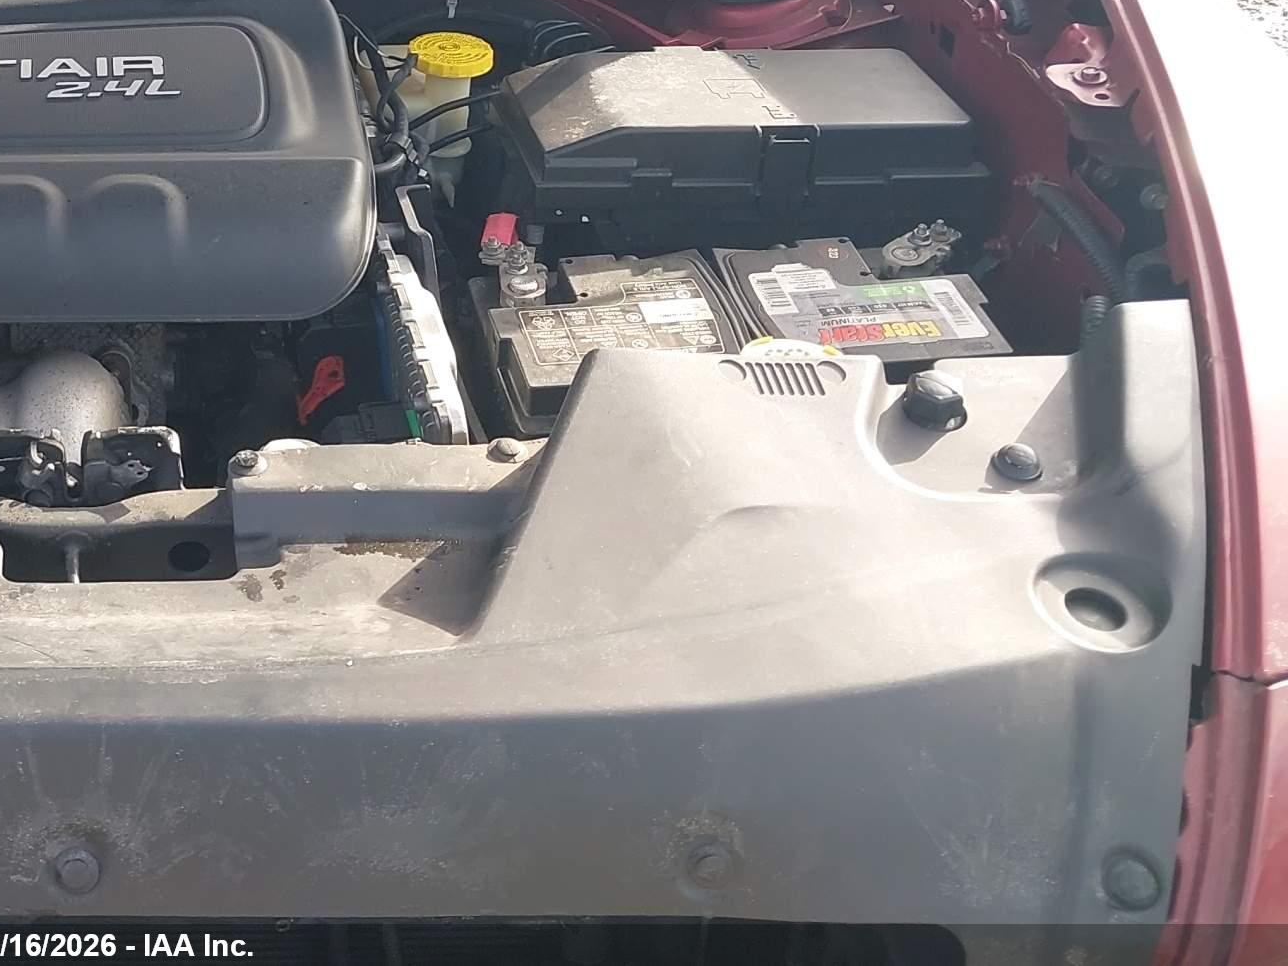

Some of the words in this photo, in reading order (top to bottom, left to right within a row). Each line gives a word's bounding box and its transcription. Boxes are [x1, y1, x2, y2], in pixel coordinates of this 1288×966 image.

[46, 78, 181, 98] 2.4L
[820, 316, 877, 327] PLATINUM
[818, 320, 941, 346] EverStart
